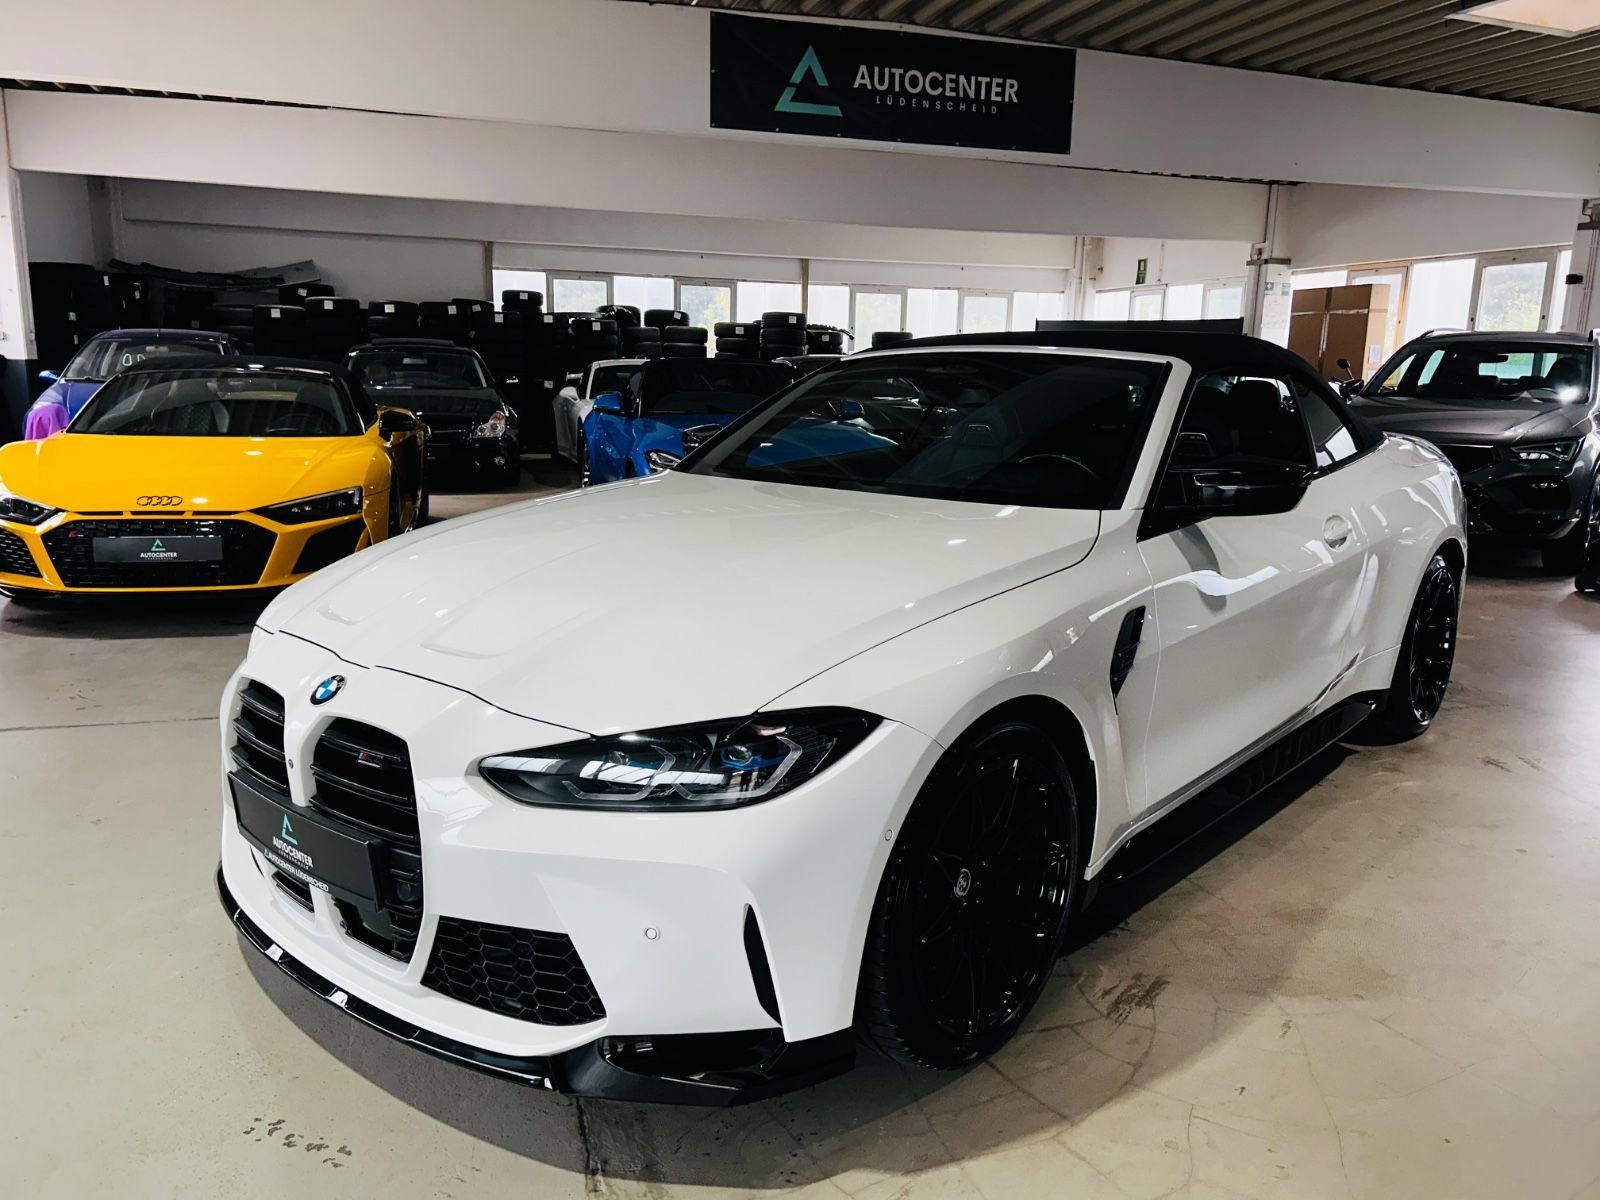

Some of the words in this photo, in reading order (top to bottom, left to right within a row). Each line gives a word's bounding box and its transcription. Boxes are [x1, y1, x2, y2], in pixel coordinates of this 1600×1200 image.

[853, 64, 1018, 103] AUTOCENTER
[876, 95, 997, 114] LÜDENSCHEID
[273, 836, 313, 868] AUTOCENTER
